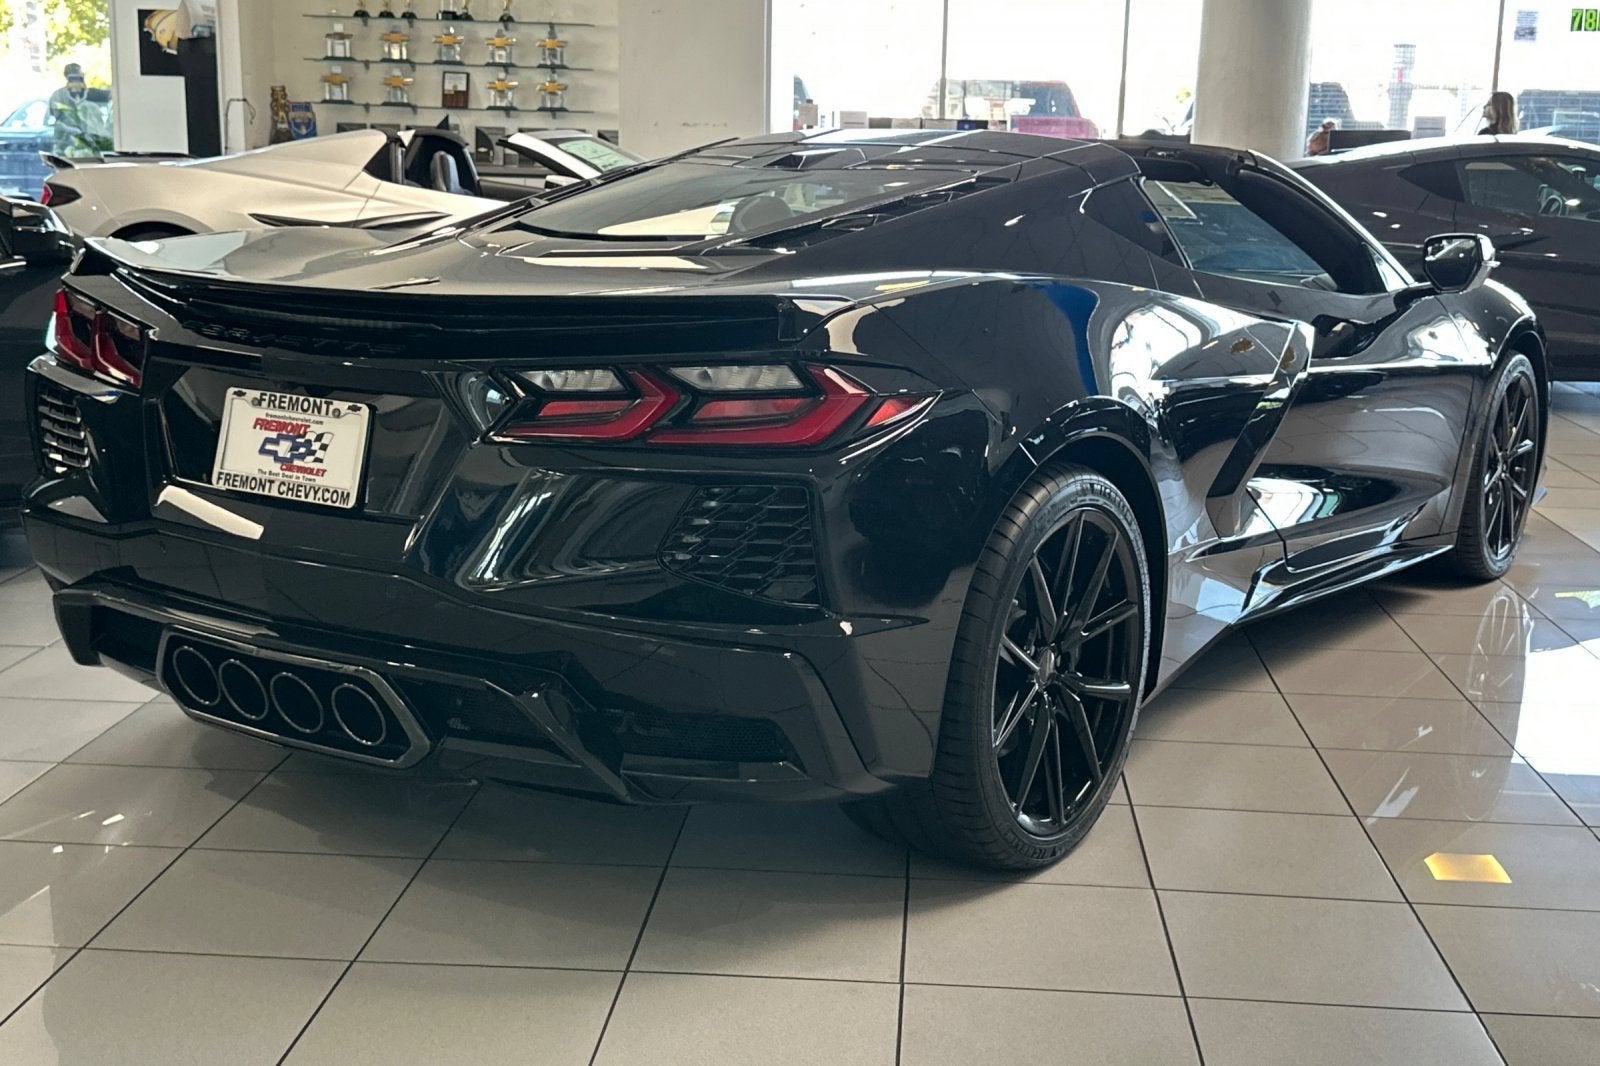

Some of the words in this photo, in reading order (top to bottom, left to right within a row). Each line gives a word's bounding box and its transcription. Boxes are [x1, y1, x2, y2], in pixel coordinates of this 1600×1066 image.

[1571, 8, 1600, 32] 78
[259, 393, 334, 416] FREMONT
[254, 418, 311, 434] FREMONT
[268, 470, 280, 478] Best
[282, 472, 294, 480] Deal
[281, 464, 328, 478] CHEVROLET
[217, 472, 275, 493] FREMONT
